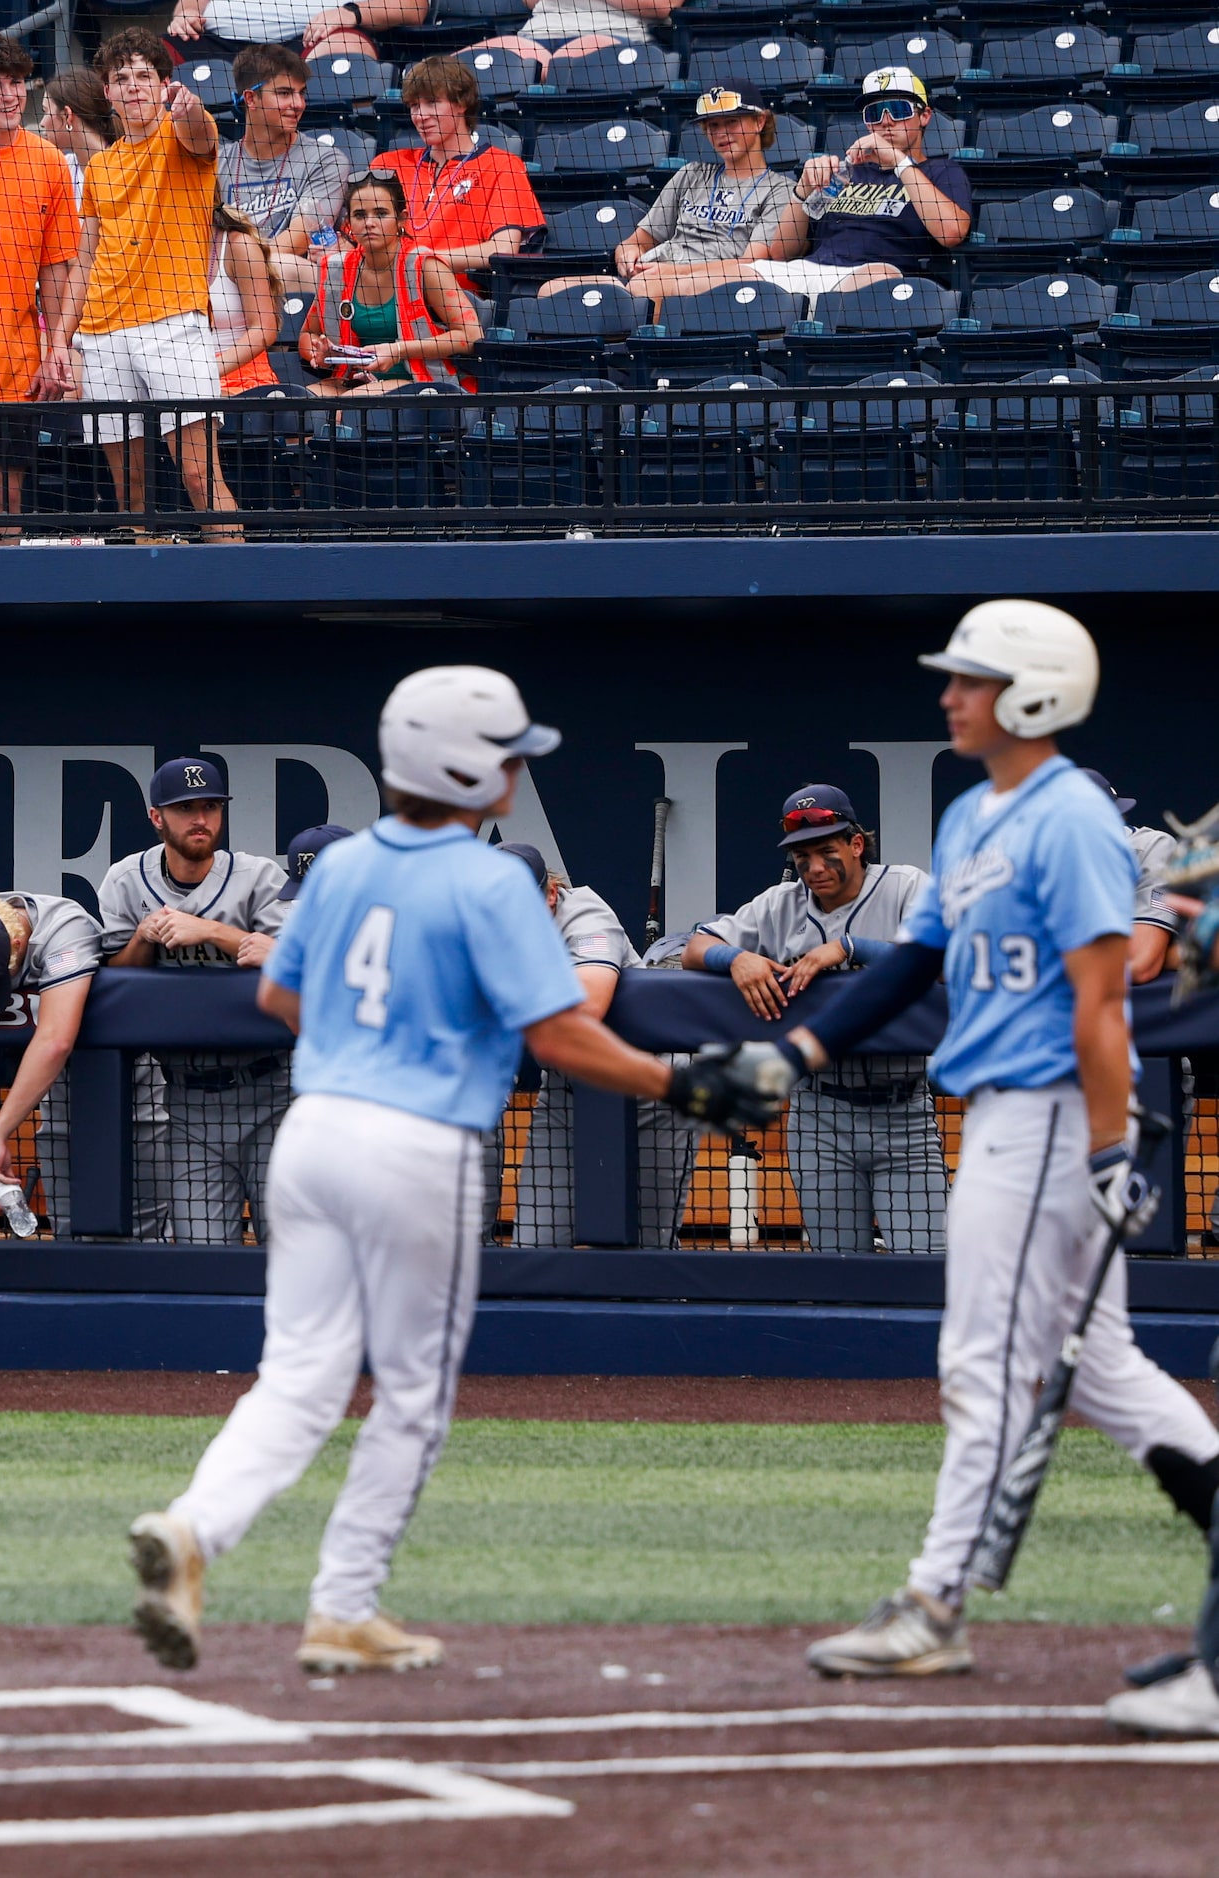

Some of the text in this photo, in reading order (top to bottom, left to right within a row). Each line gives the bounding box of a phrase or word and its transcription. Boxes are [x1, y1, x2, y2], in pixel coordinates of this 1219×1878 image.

[184, 765, 207, 788] K
[343, 903, 397, 1030] 4
[970, 931, 1038, 993] 13
